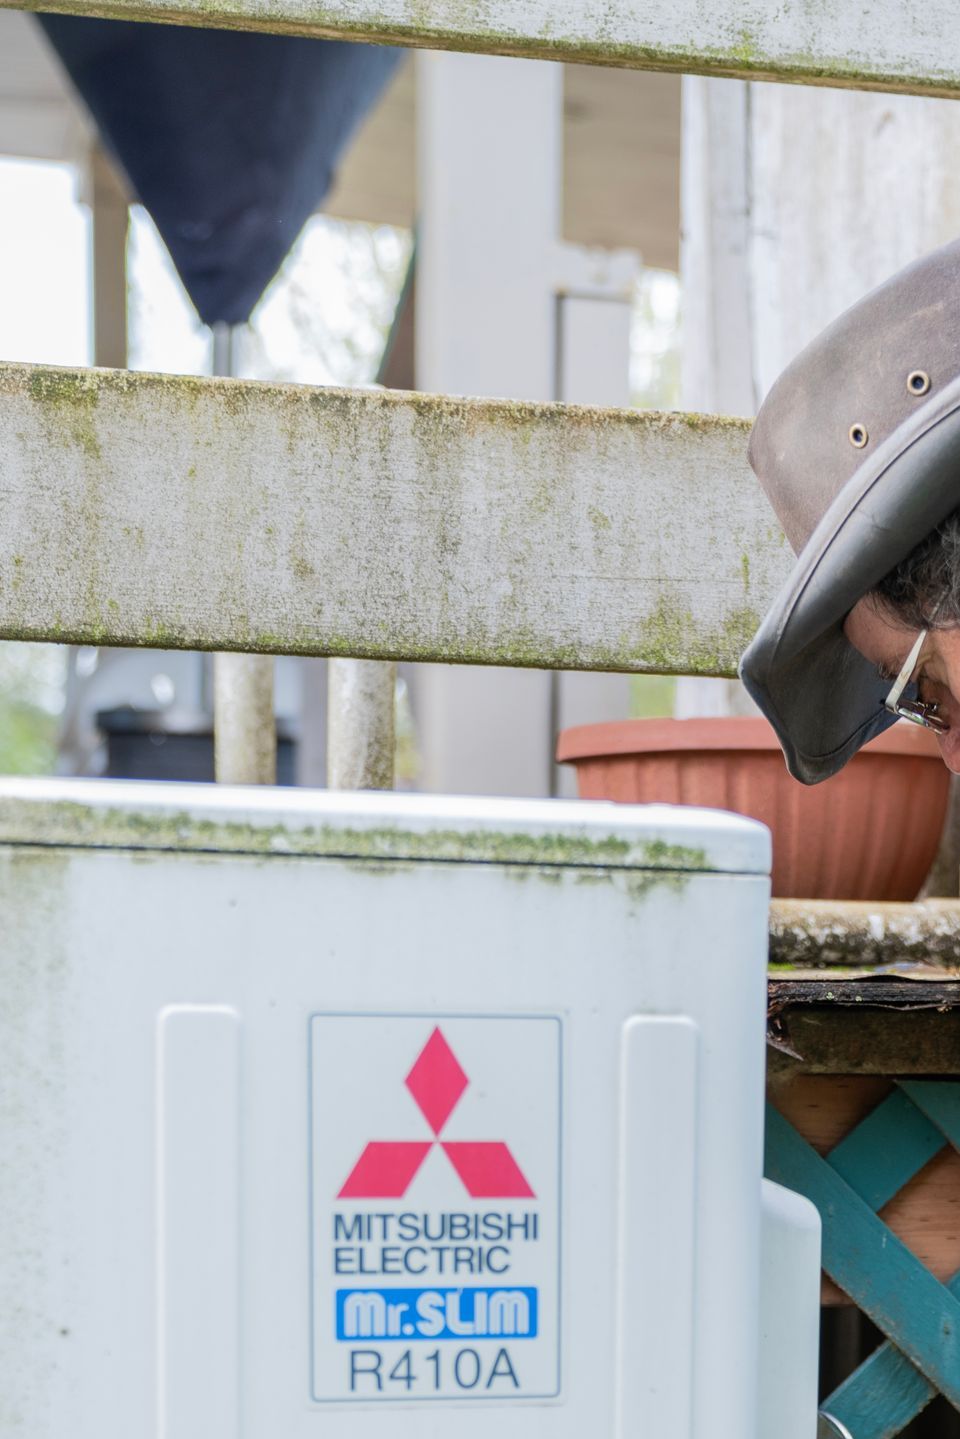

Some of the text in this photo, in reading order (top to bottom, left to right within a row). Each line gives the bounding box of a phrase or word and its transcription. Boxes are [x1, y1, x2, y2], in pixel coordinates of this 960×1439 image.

[333, 1212, 538, 1241] MITSUBISHI
[333, 1246, 511, 1275] ELECTRIC
[348, 1348, 520, 1392] R410A
